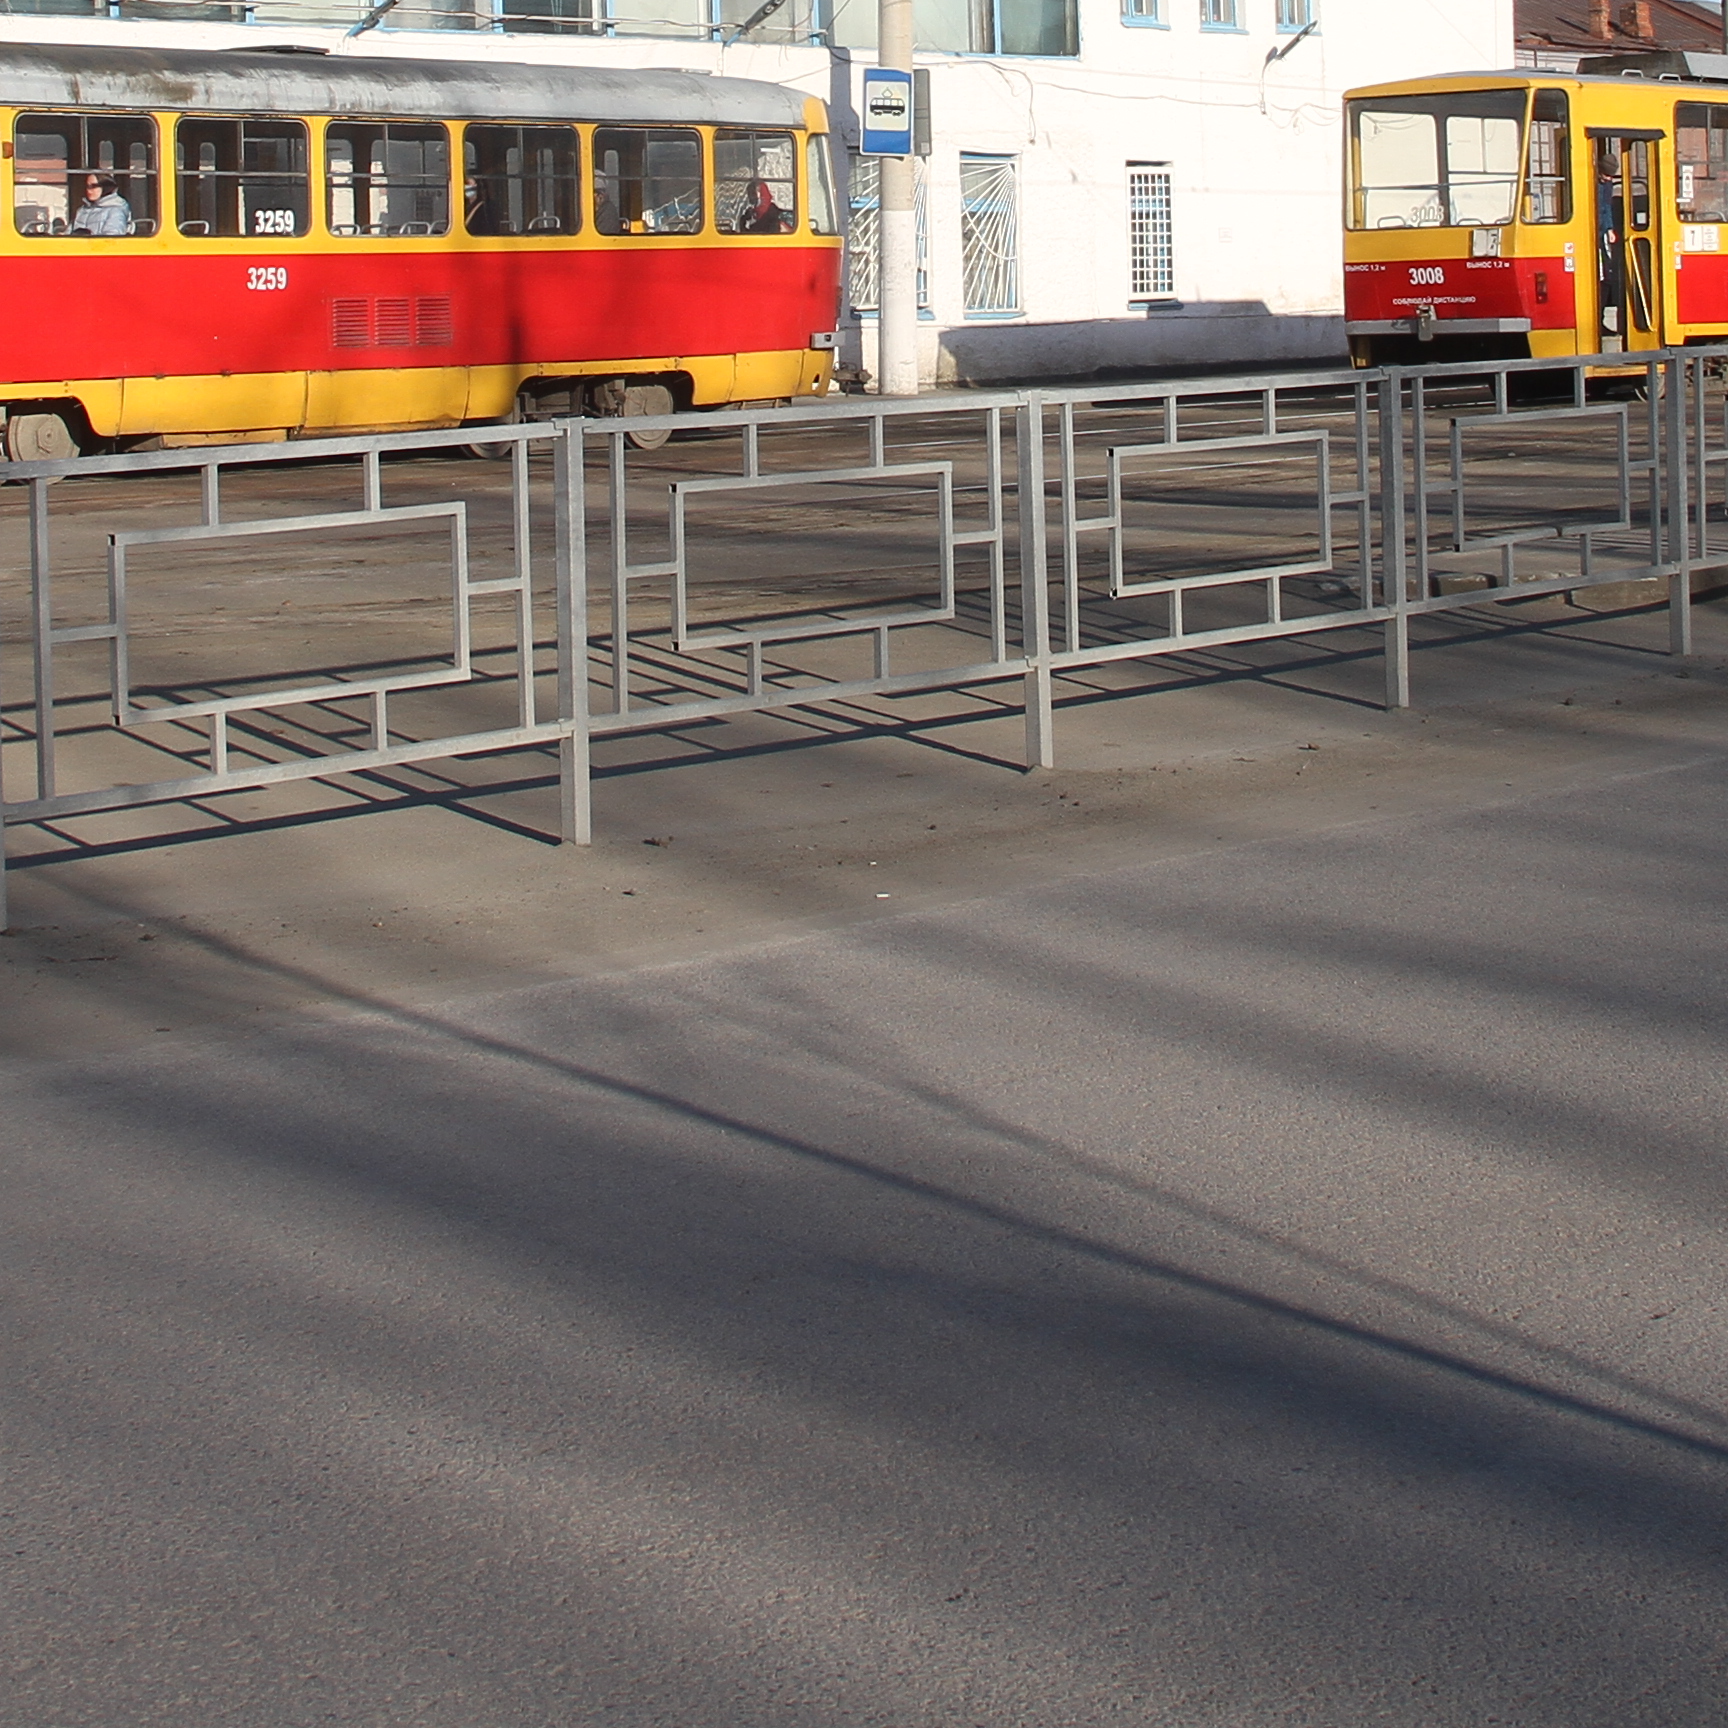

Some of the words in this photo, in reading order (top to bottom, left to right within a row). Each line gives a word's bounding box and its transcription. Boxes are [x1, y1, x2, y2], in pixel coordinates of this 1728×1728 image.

[255, 209, 295, 234] 3259
[1411, 205, 1444, 223] 3008
[247, 267, 288, 291] 3259
[1409, 267, 1445, 285] 3008
[1392, 295, 1432, 306] СОБЛЮДАЙ
[1432, 295, 1476, 305] ДИСТАНЦИЮ
